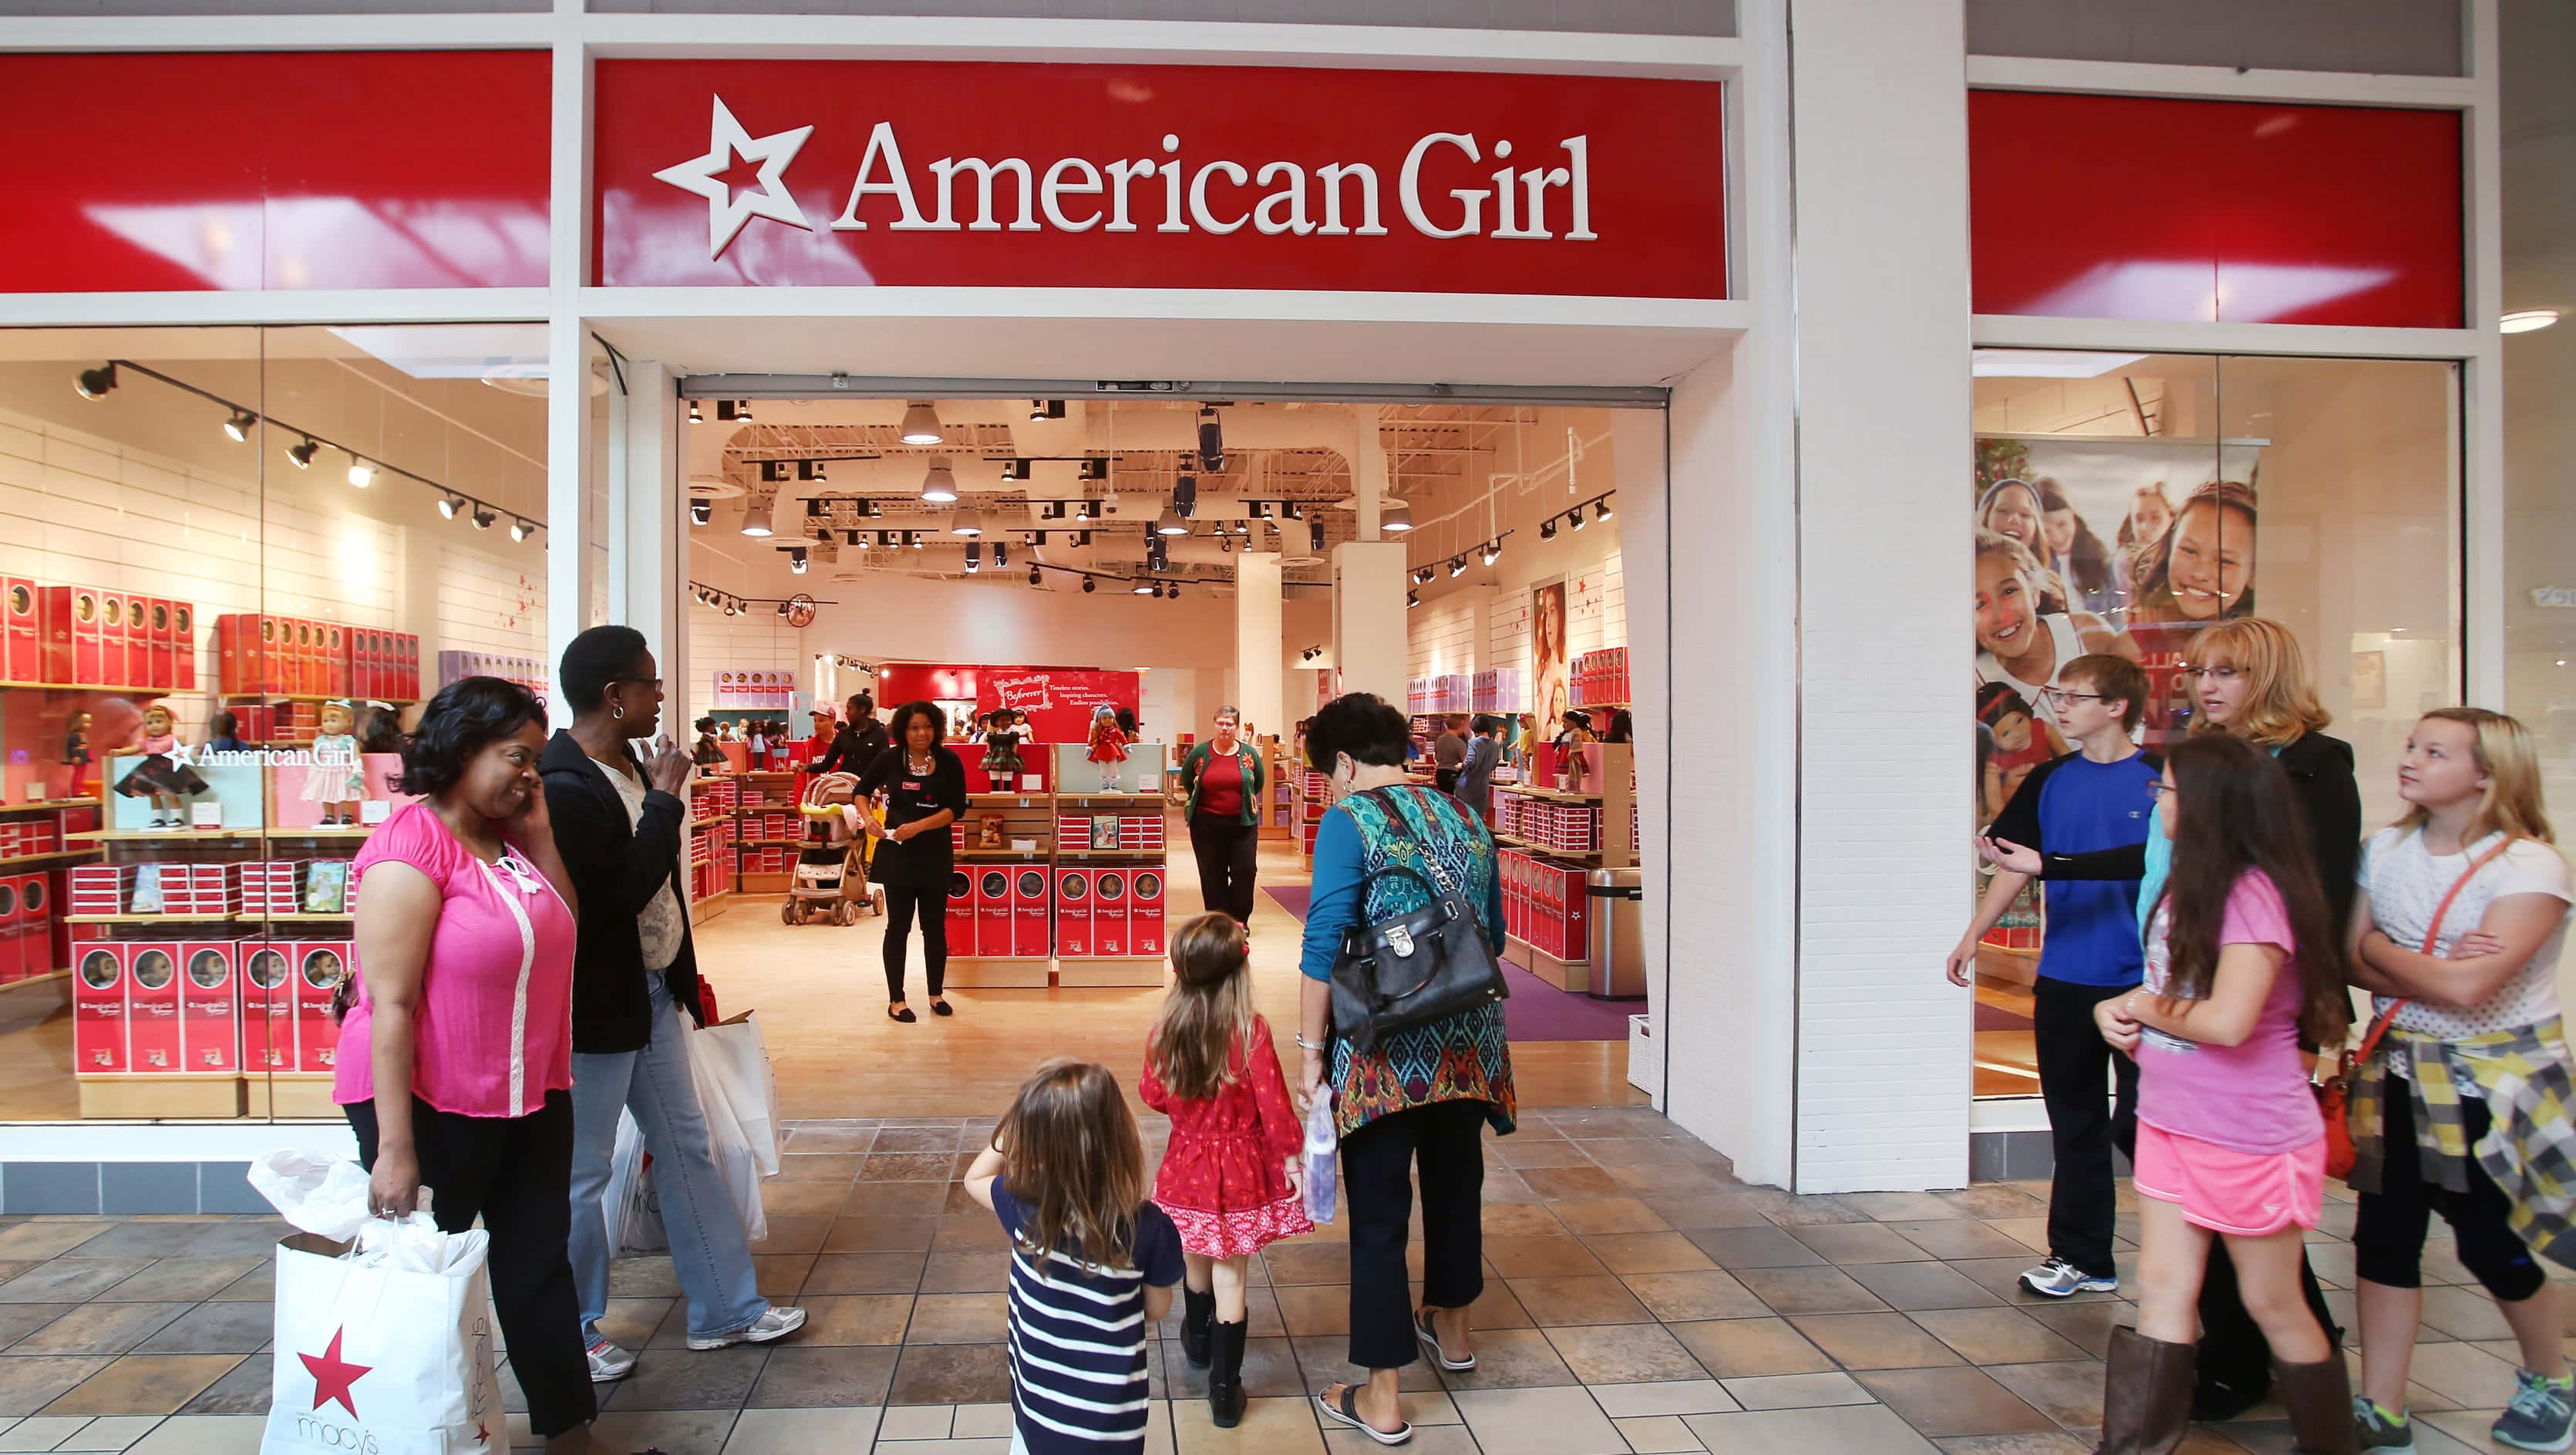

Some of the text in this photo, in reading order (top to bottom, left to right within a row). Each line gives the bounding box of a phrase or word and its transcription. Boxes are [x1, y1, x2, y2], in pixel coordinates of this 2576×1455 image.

[831, 121, 1598, 241] American Girl
[198, 743, 355, 766] American Girl
